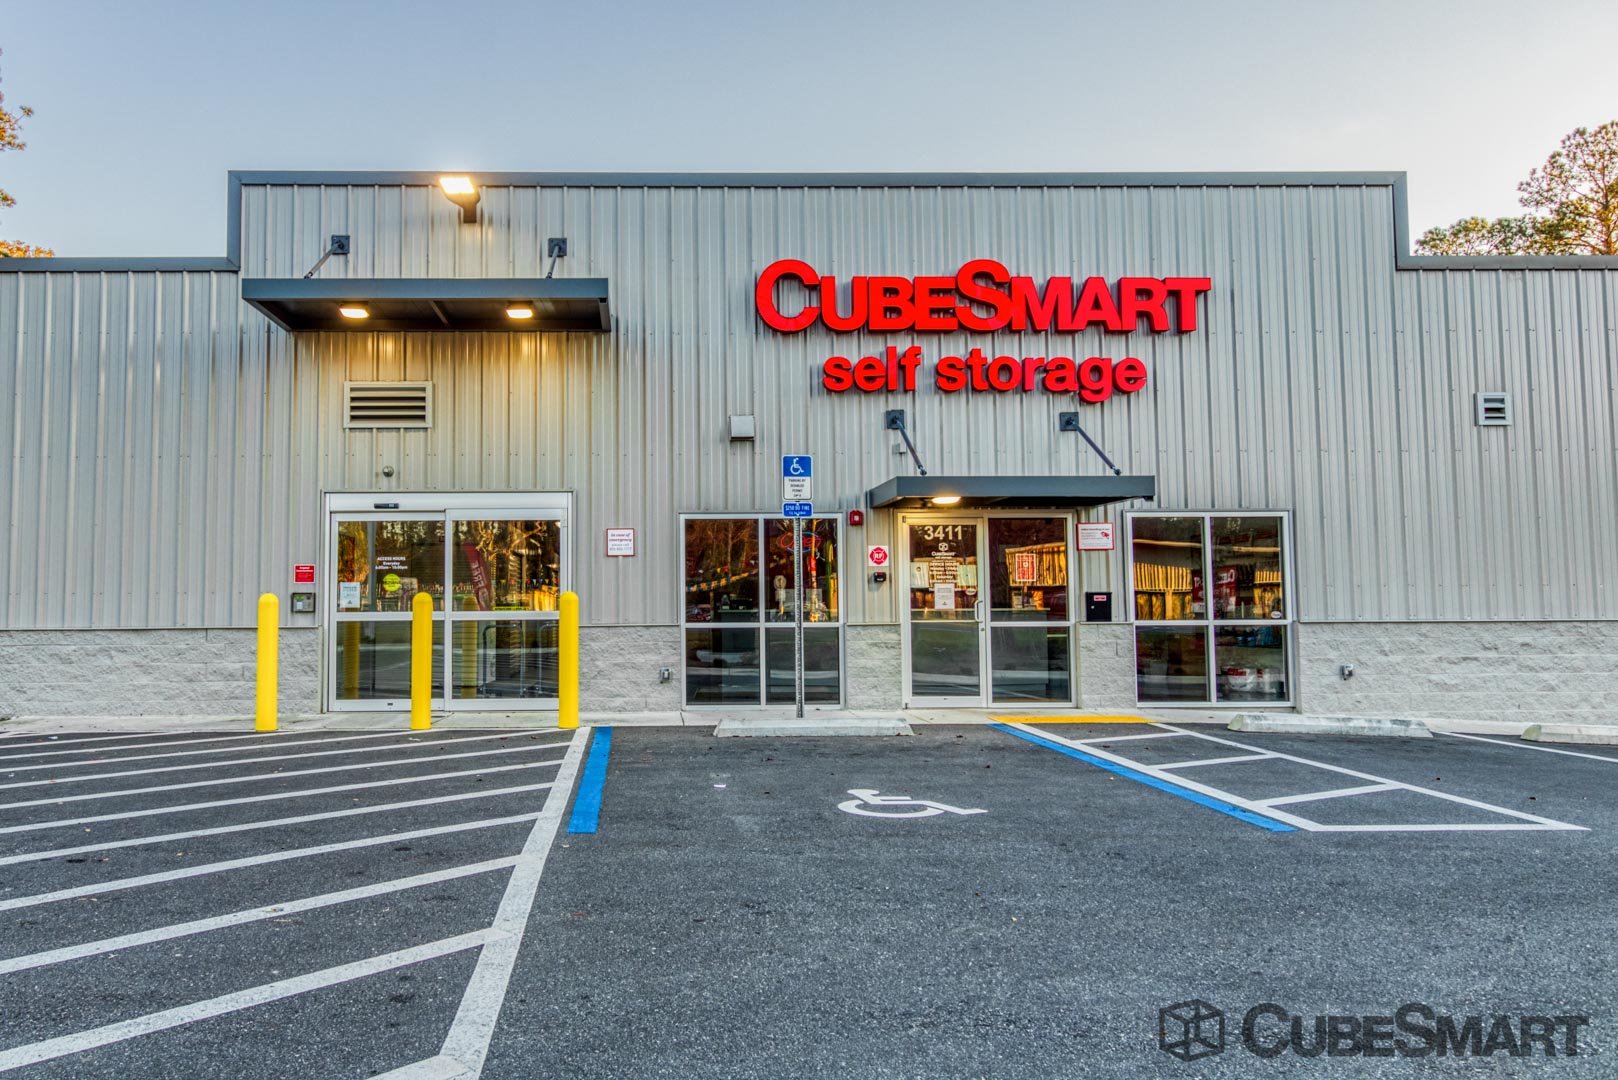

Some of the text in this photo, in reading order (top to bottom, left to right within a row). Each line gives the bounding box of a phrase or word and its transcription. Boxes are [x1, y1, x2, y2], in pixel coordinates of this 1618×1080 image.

[822, 346, 1147, 403] self storage
[924, 525, 962, 540] 3411
